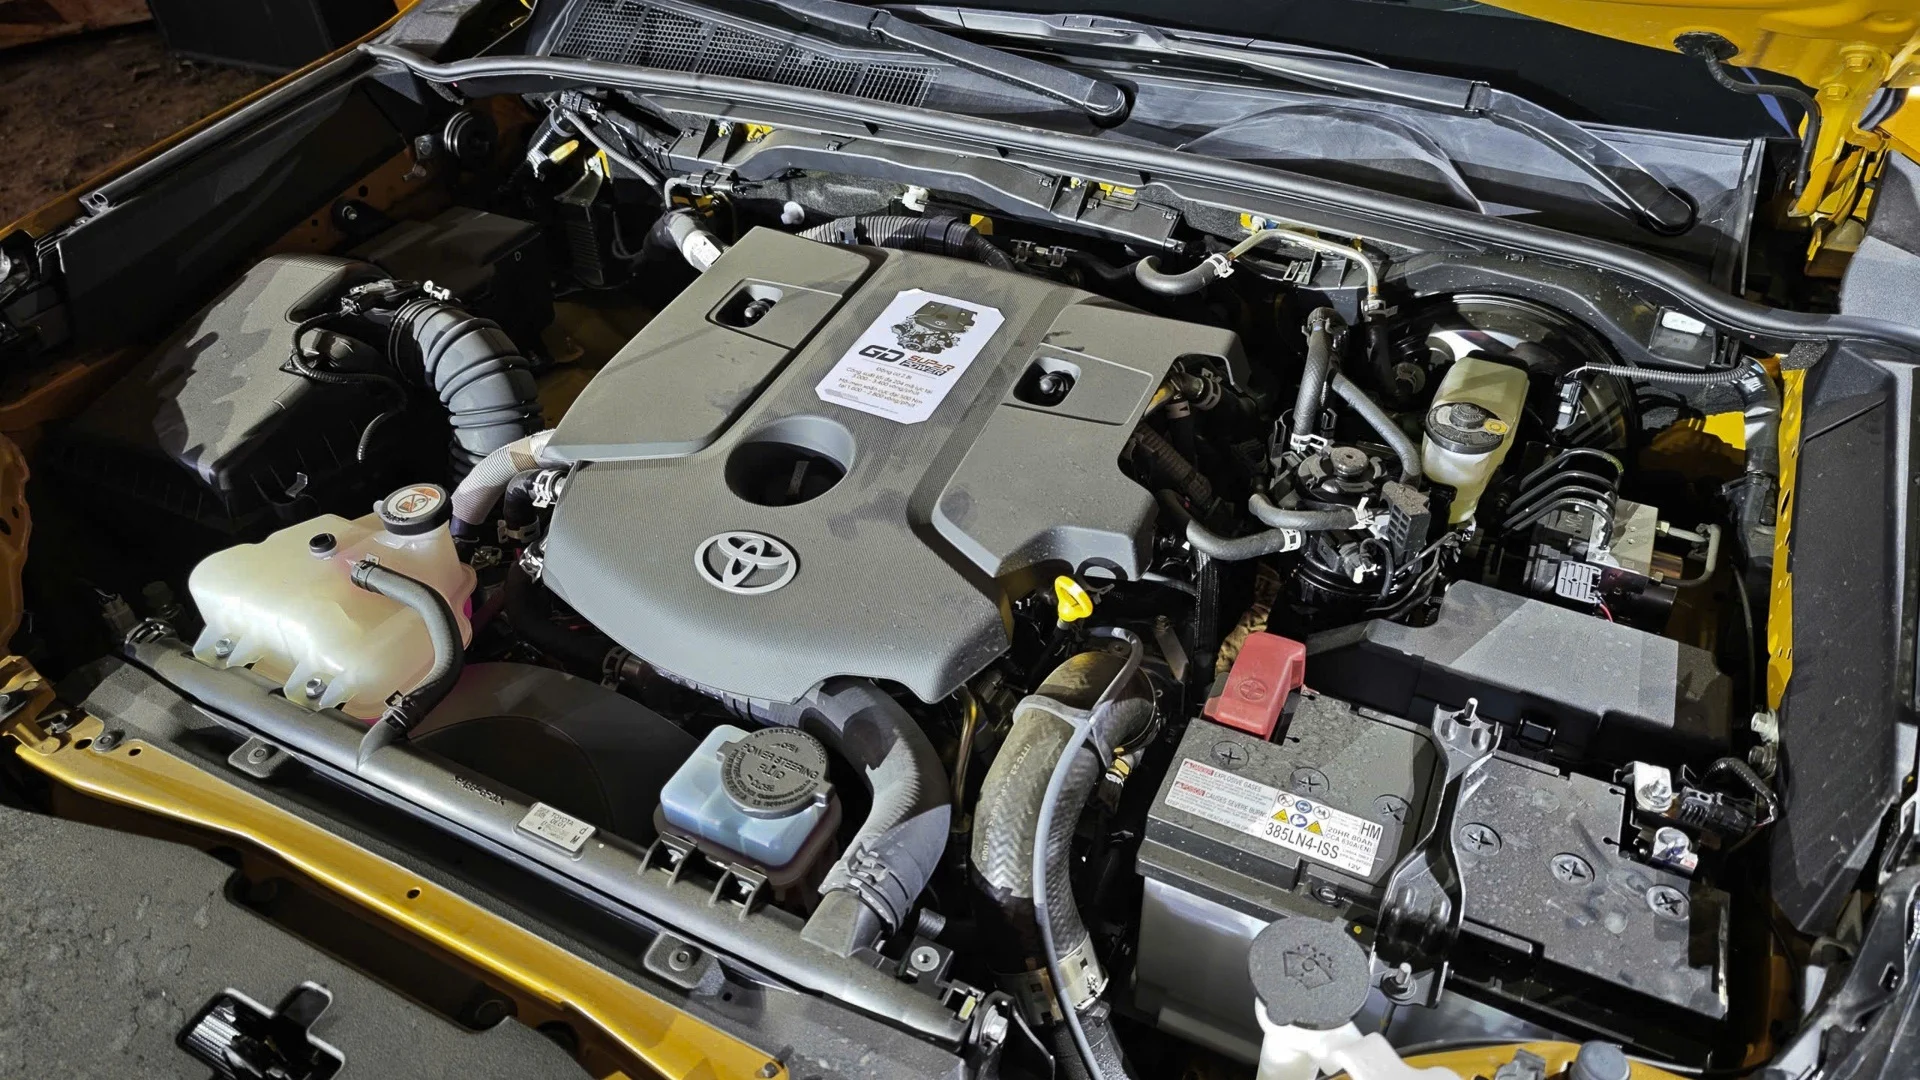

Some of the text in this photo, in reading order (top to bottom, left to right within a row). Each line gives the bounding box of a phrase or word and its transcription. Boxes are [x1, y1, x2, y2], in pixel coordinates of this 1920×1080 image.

[858, 344, 905, 362] GD
[898, 359, 947, 376] POWER
[907, 354, 956, 371] SUPER
[741, 743, 775, 760] POWER
[774, 756, 819, 780] STEERING
[751, 779, 775, 792] CLOSE
[1213, 771, 1243, 786] EXPLOSIVE
[1242, 781, 1262, 792] GASES
[1204, 791, 1227, 804] CAUSES
[1226, 799, 1248, 811] SEVERE
[550, 812, 575, 826] TOYOTA
[1325, 832, 1340, 841] CCA
[1327, 826, 1350, 838] 20HR
[1360, 821, 1381, 840] HM
[1264, 821, 1340, 859] 385LN4-ISS
